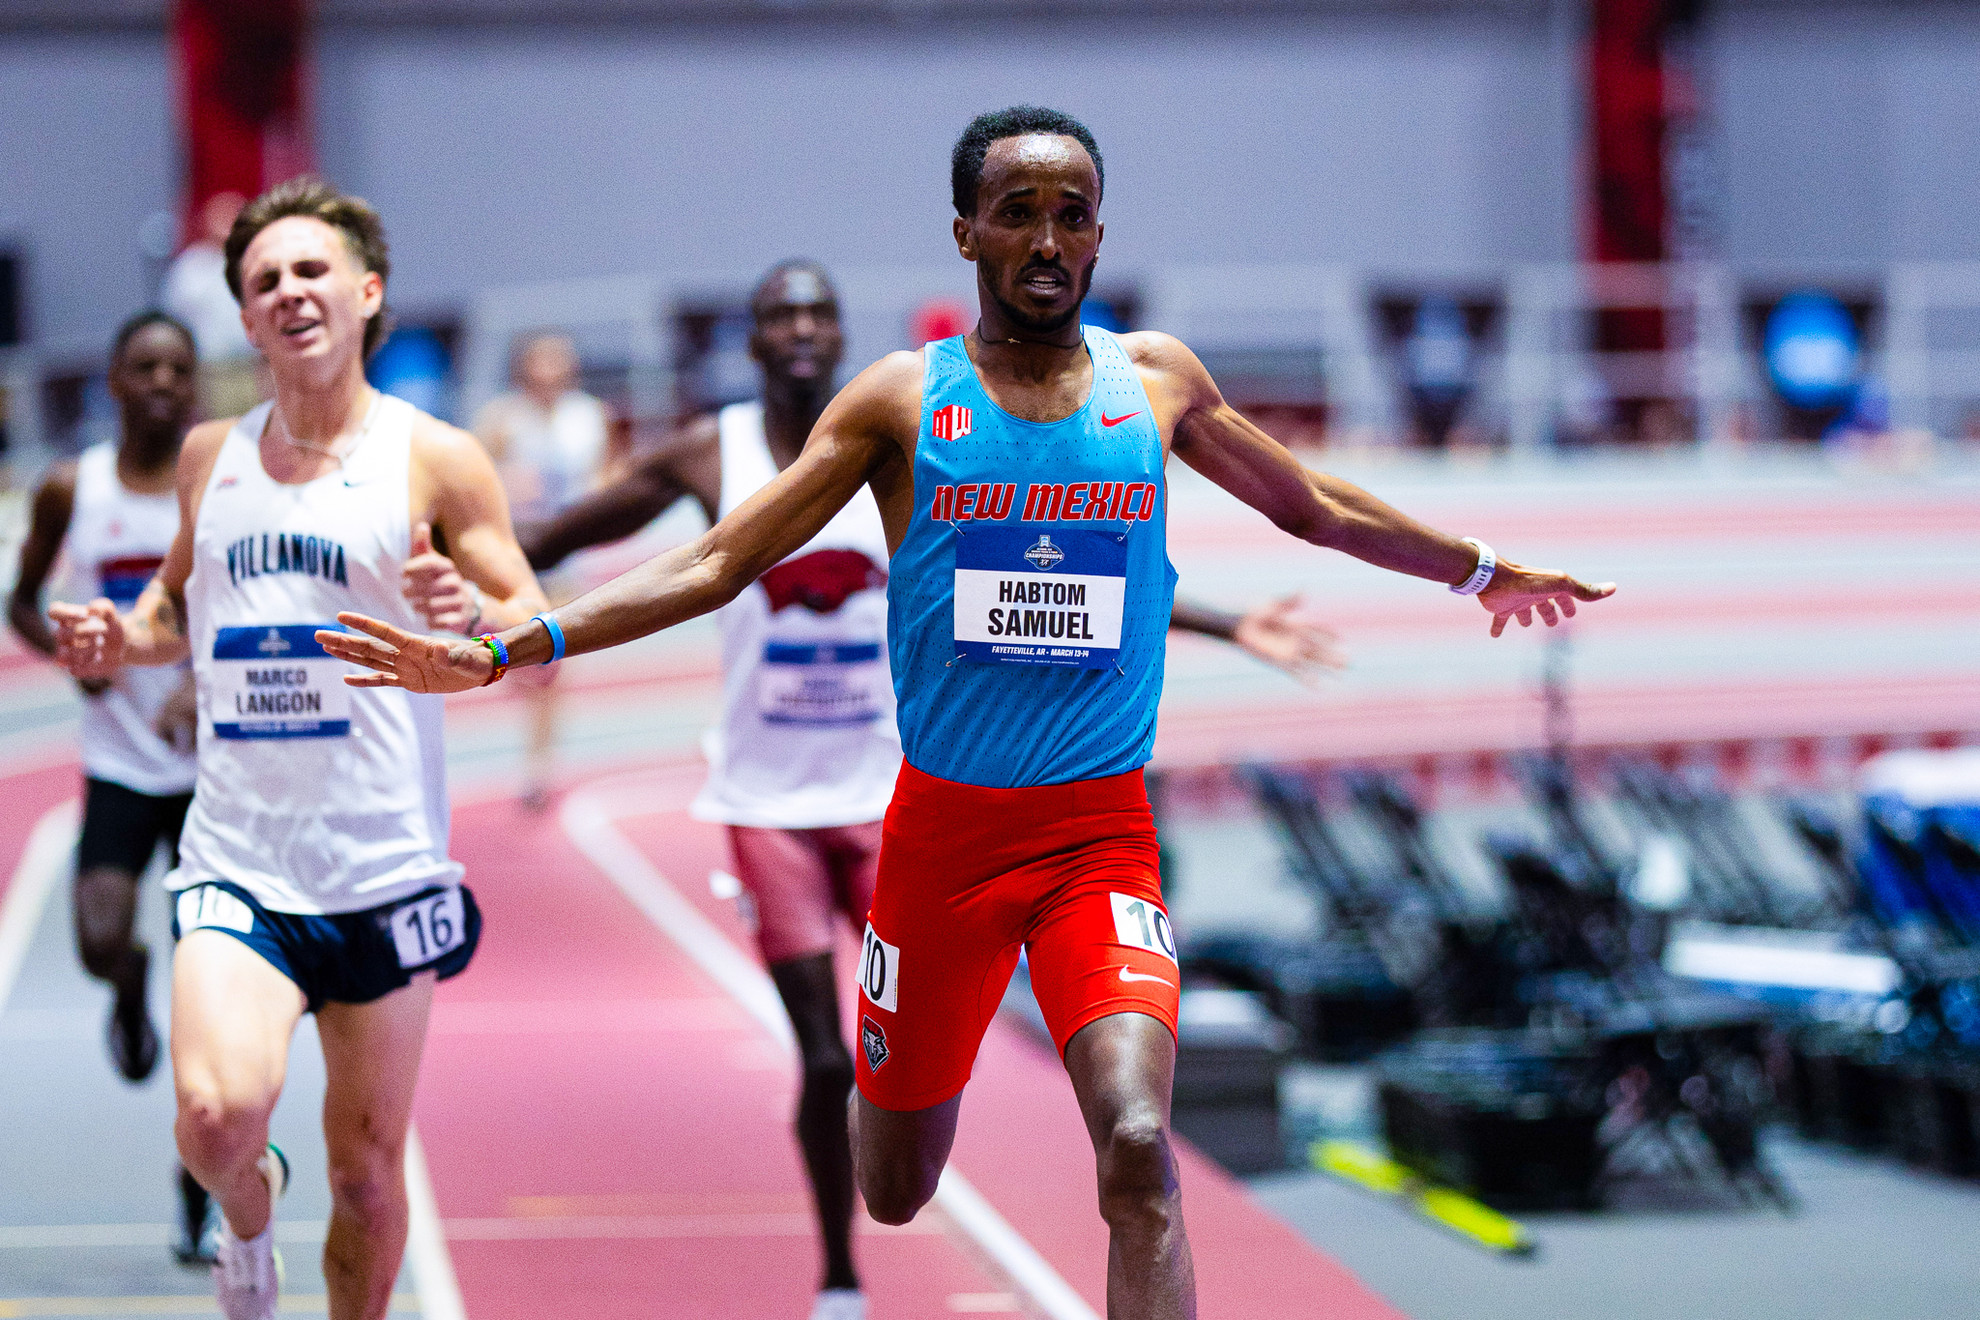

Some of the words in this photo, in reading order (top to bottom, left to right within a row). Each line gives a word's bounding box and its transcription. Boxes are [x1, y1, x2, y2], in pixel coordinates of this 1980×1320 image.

[931, 483, 1017, 521] NEW
[1021, 482, 1156, 521] MEXICO
[226, 533, 348, 587] VILLANOVA
[999, 580, 1086, 606] HABTOM
[987, 608, 1094, 640] SAMUEL
[991, 645, 1035, 656] FAYETTEVILLE,
[1036, 647, 1045, 656] AR
[1050, 648, 1073, 657] MARCH
[1074, 649, 1090, 658] 13-14
[246, 668, 308, 686] MARCO
[236, 691, 321, 714] LANGON
[406, 901, 453, 955] 16
[1126, 901, 1176, 959] 10
[865, 931, 887, 1002] 10
